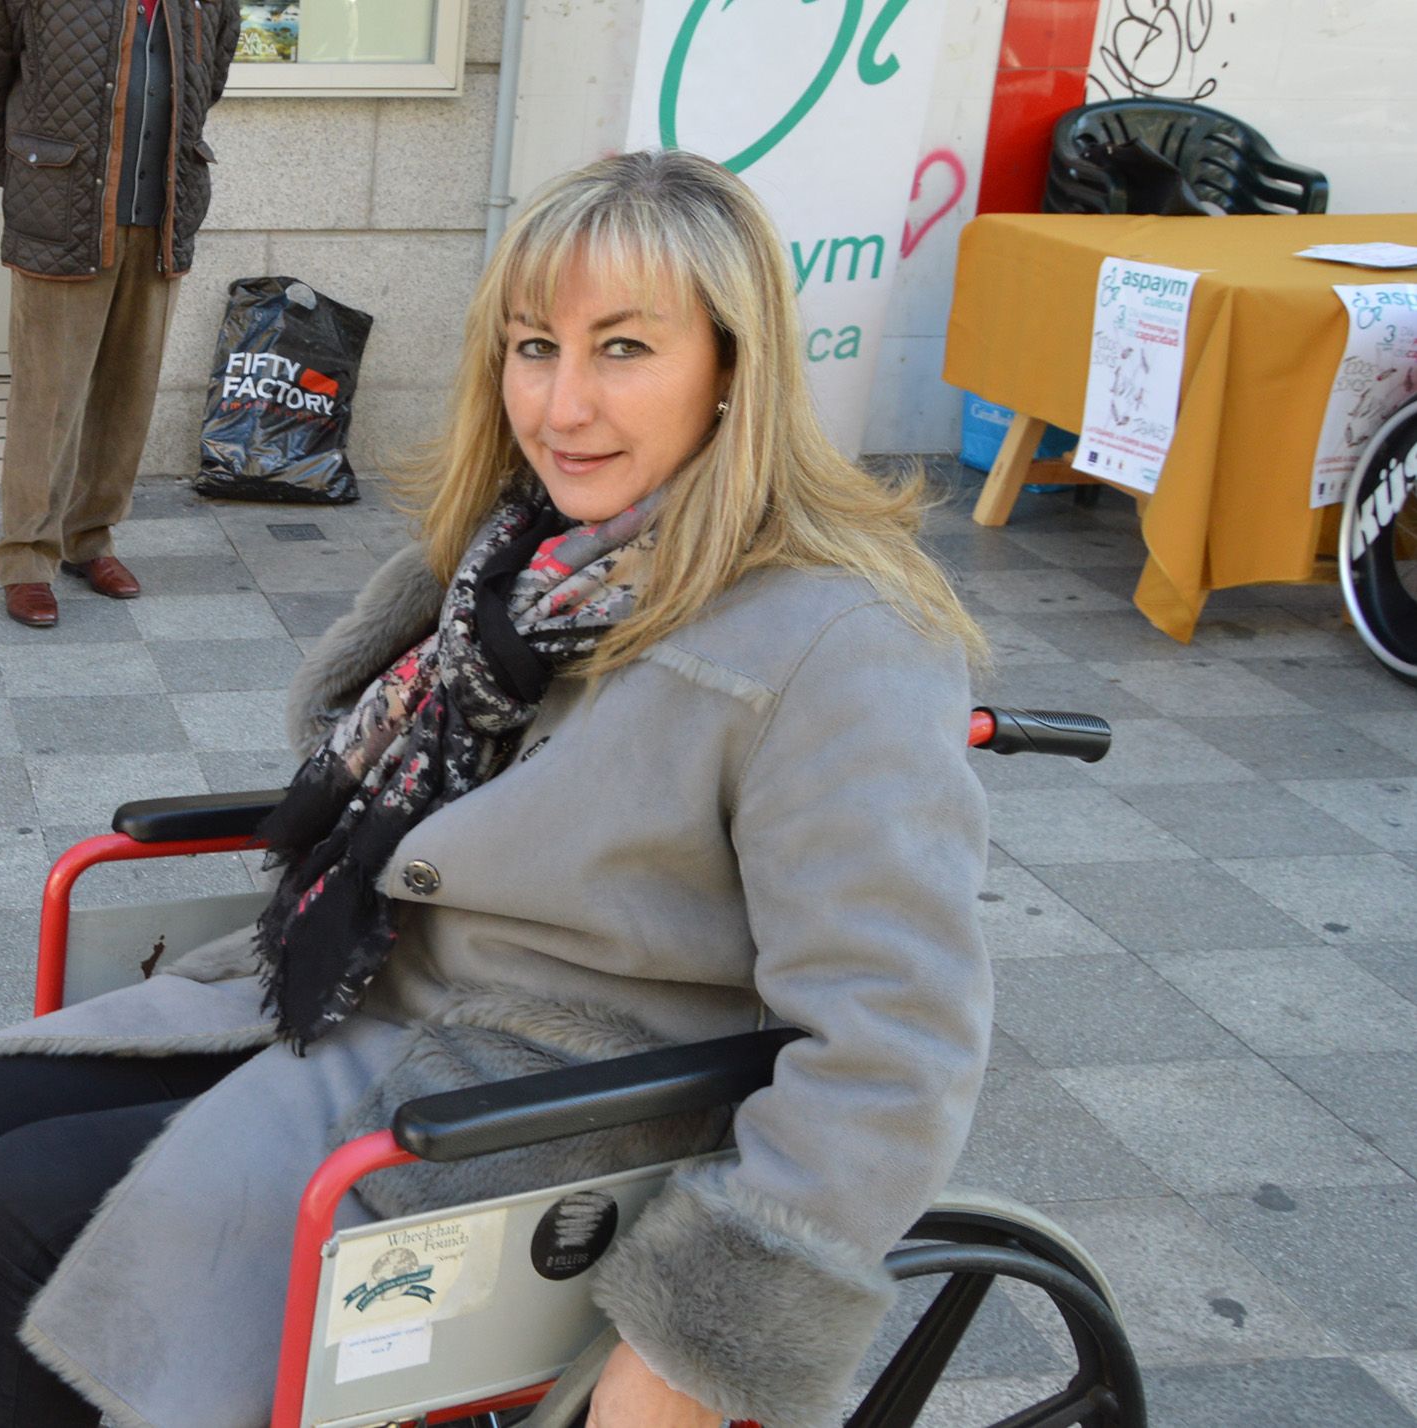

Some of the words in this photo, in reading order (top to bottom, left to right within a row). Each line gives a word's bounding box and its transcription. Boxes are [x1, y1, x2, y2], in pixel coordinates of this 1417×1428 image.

[790, 234, 886, 295] ym
[1122, 270, 1189, 297] aspaym
[1143, 296, 1185, 313] cuenca
[806, 325, 862, 363] ca
[225, 352, 302, 382] FIFTY
[222, 375, 335, 417] FACTORY
